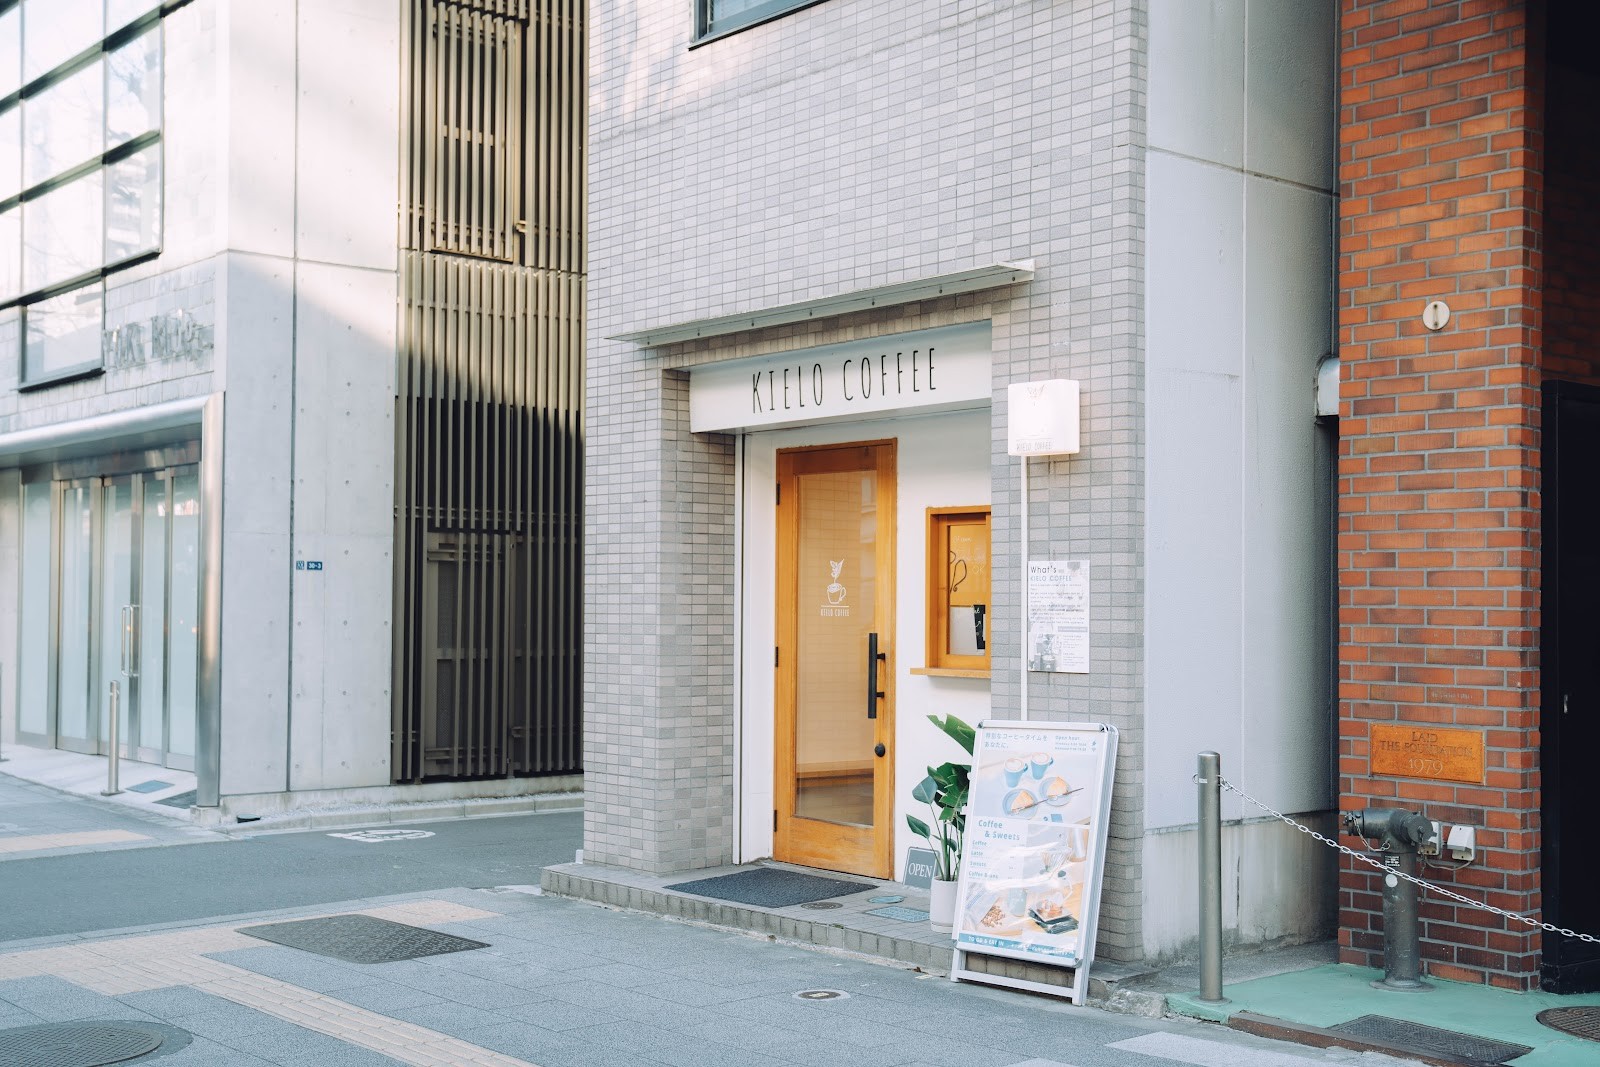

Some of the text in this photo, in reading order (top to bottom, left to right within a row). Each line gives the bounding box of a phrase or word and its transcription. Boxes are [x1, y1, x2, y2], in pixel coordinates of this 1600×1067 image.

[752, 347, 937, 414] KIELO COFFEE
[1016, 441, 1052, 452] KIELO COFFEE
[1030, 565, 1057, 574] What's
[820, 608, 850, 617] KIELO COFFEE
[1411, 731, 1438, 743] LAID
[1379, 740, 1473, 759] THE FOUNDATION
[1408, 758, 1444, 776] 1979
[978, 819, 1003, 829] Coffee
[984, 830, 1021, 841] & Sweets
[972, 839, 987, 847] Coffee
[908, 862, 933, 878] OPEN
